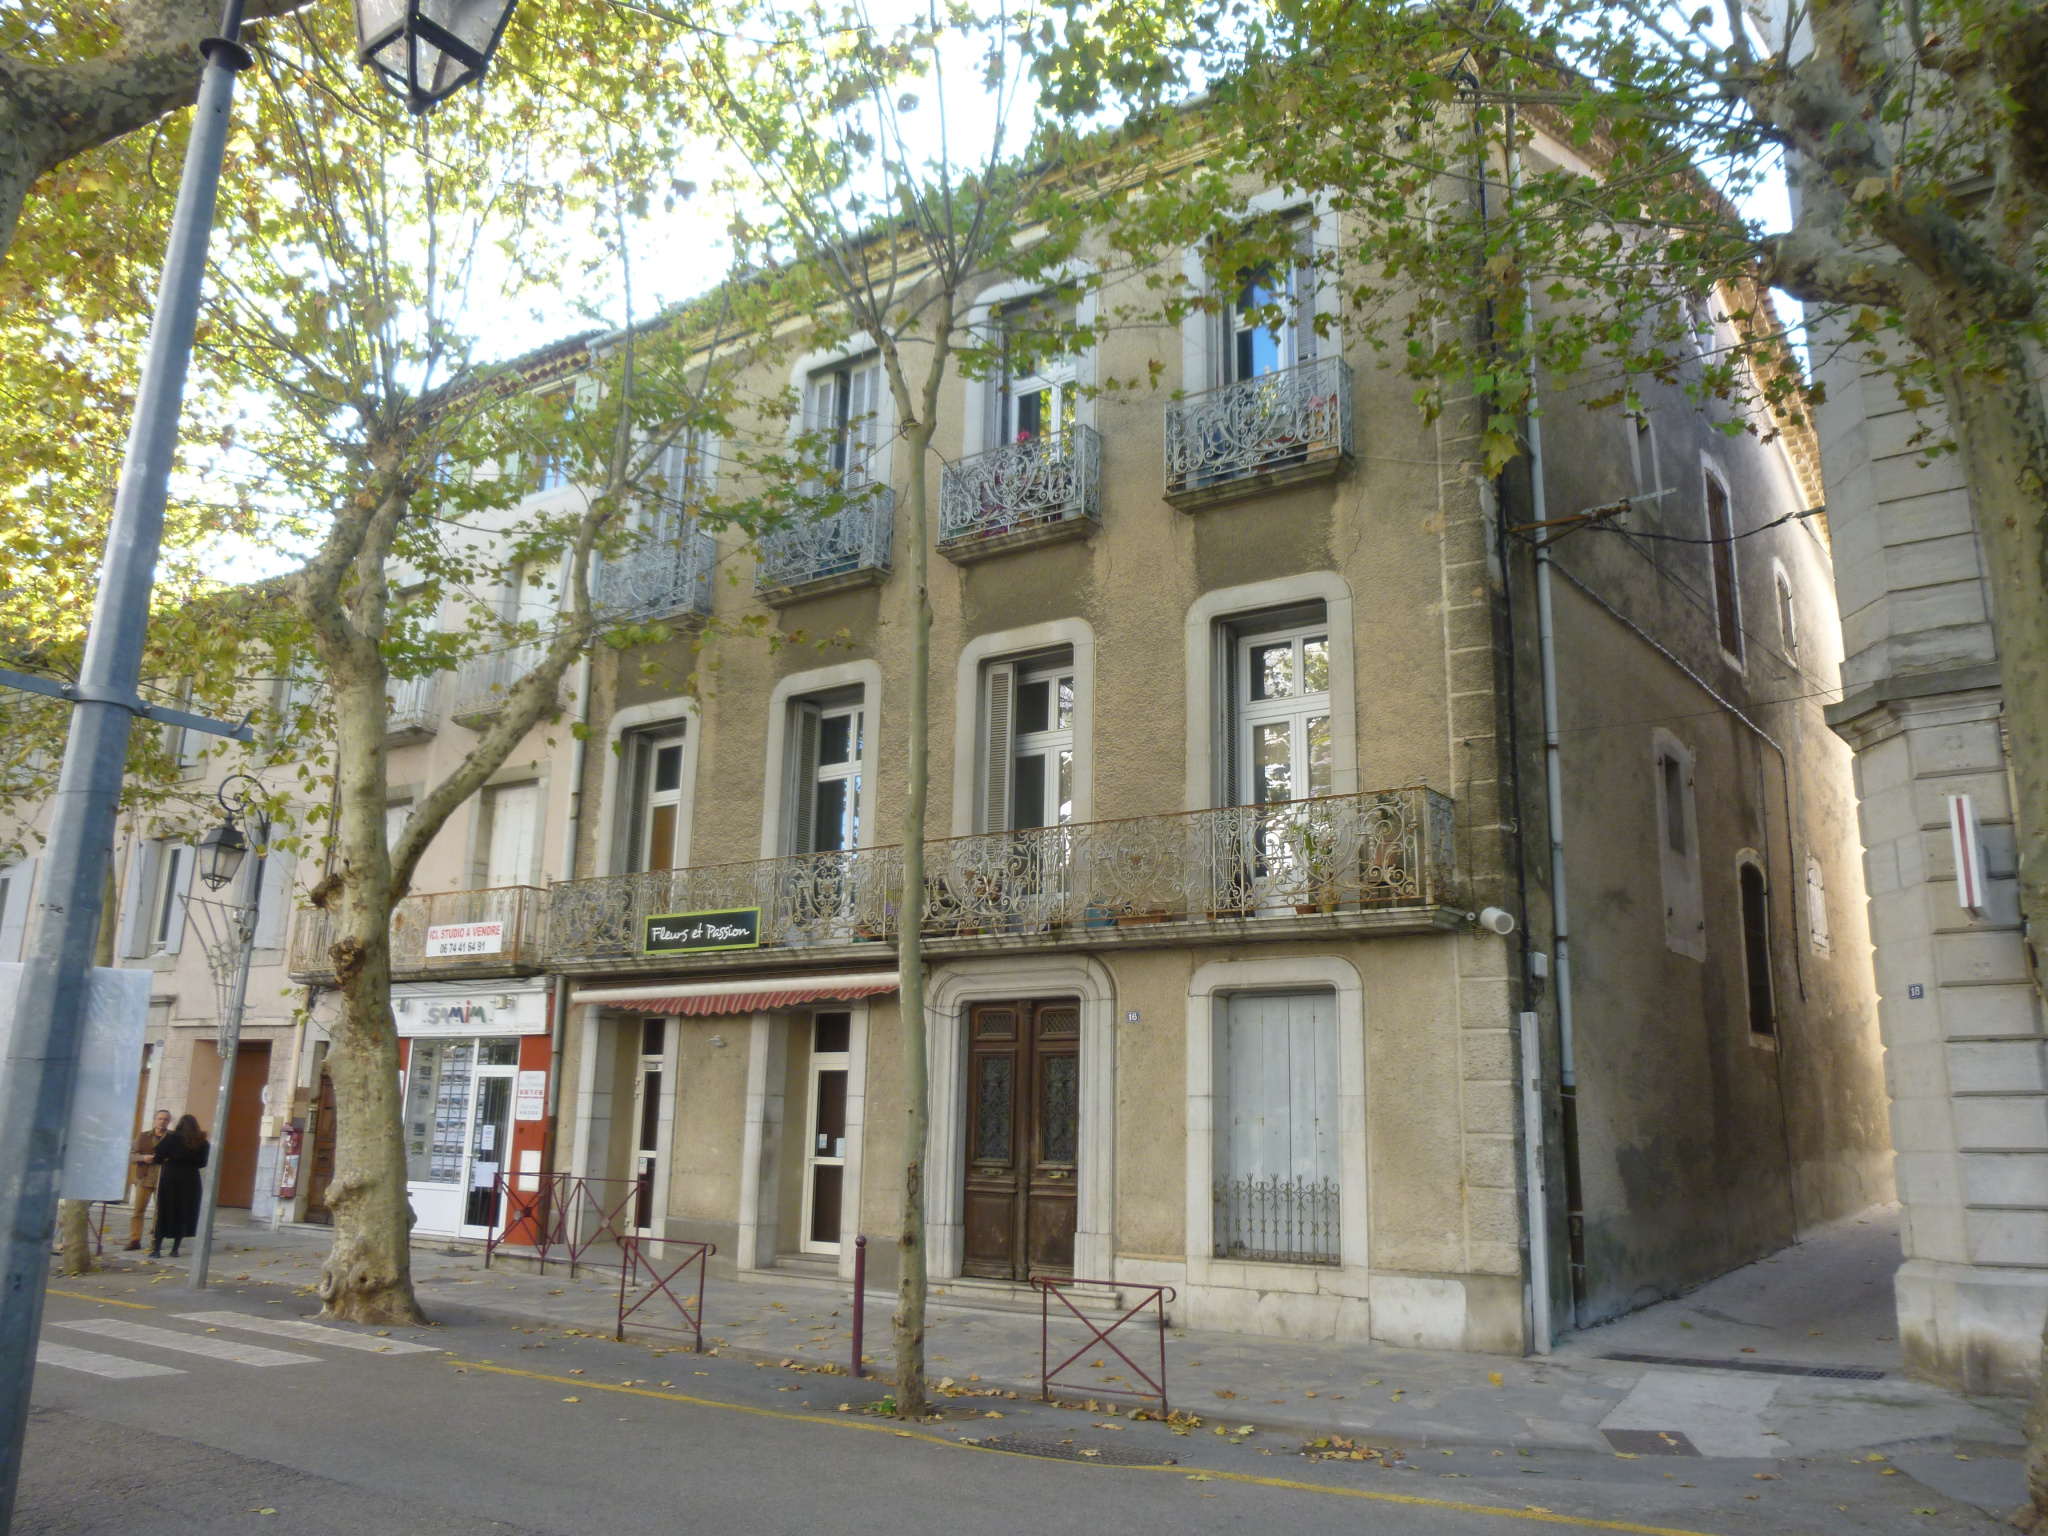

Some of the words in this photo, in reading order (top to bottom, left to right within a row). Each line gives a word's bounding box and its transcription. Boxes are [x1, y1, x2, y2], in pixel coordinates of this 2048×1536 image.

[441, 928, 465, 939] STUDIO
[466, 927, 471, 937] A
[473, 925, 501, 937] VENDRE
[652, 926, 689, 942] Fleurs
[692, 922, 704, 939] et
[706, 924, 750, 940] Passion
[440, 944, 448, 953] 06
[450, 943, 457, 952] 74
[458, 942, 466, 952] 41
[468, 942, 475, 952] 64
[477, 941, 486, 951] 91
[1910, 986, 1920, 996] 18
[1128, 1013, 1138, 1021] 16
